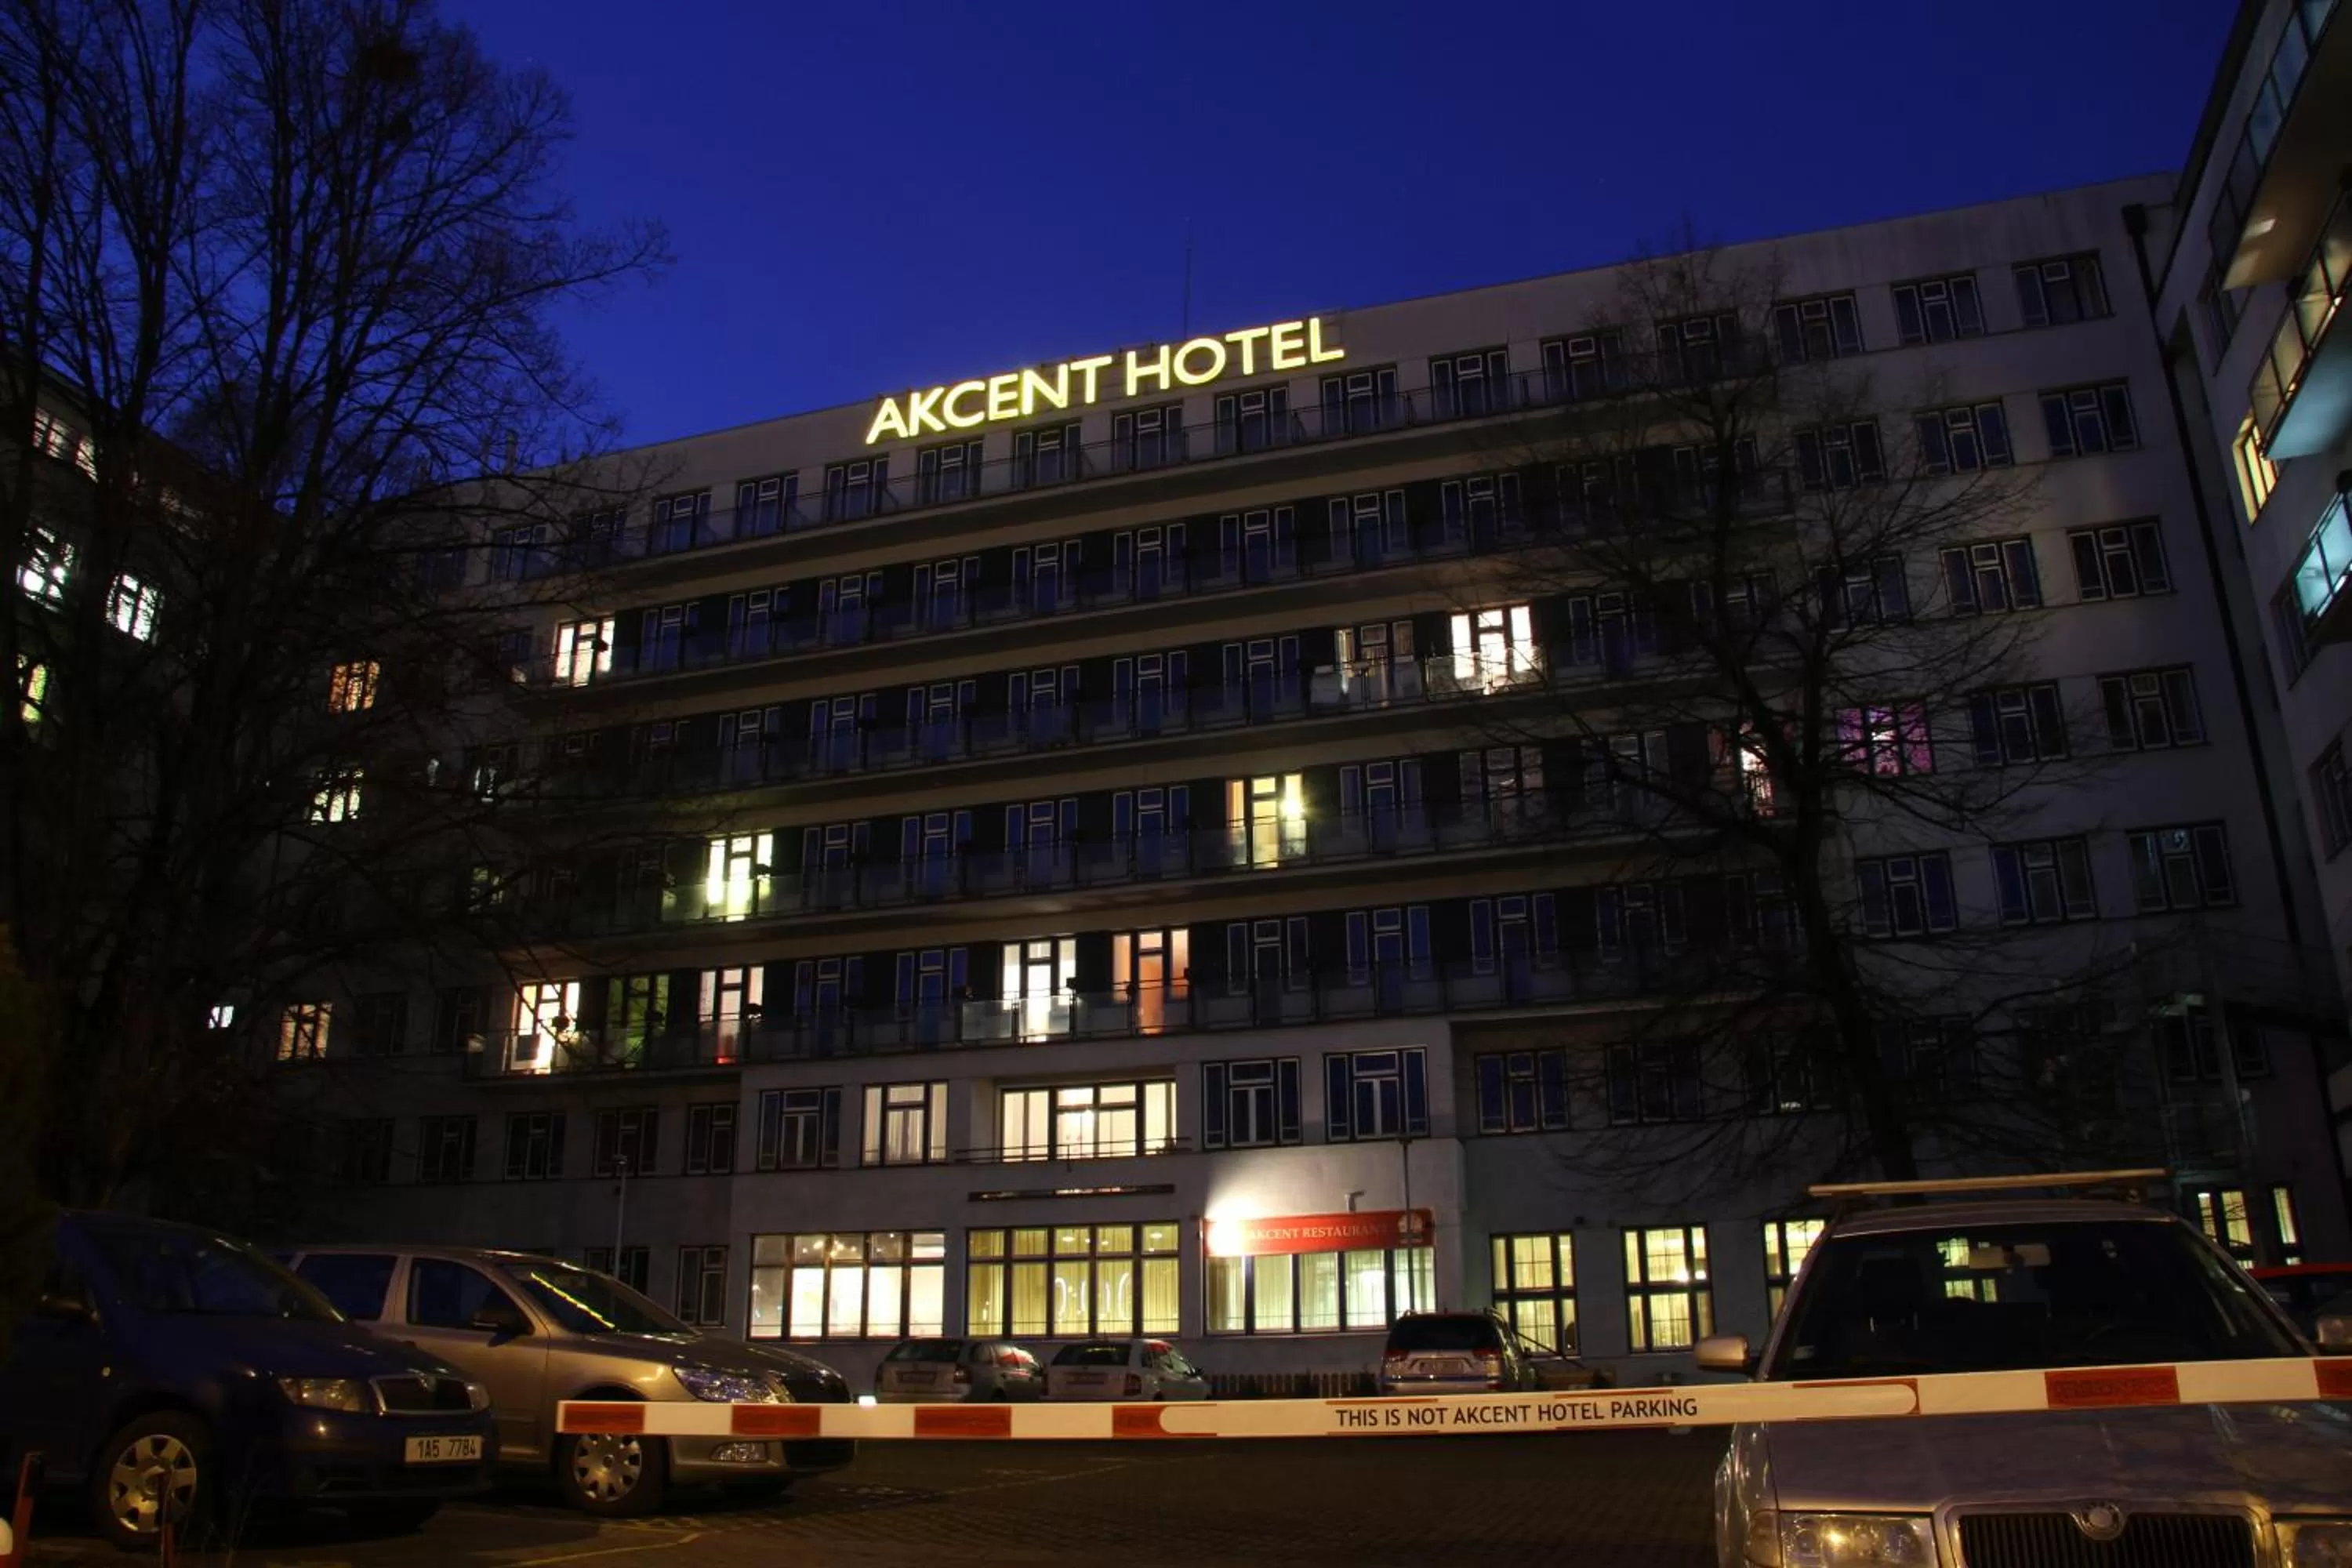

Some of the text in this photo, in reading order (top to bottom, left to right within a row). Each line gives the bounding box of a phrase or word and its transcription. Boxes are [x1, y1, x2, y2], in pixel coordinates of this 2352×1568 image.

[865, 317, 1345, 445] AKCENT HOTEL
[1336, 1398, 1698, 1428] THIS IS NOT AKCENT HOTEL PARKING
